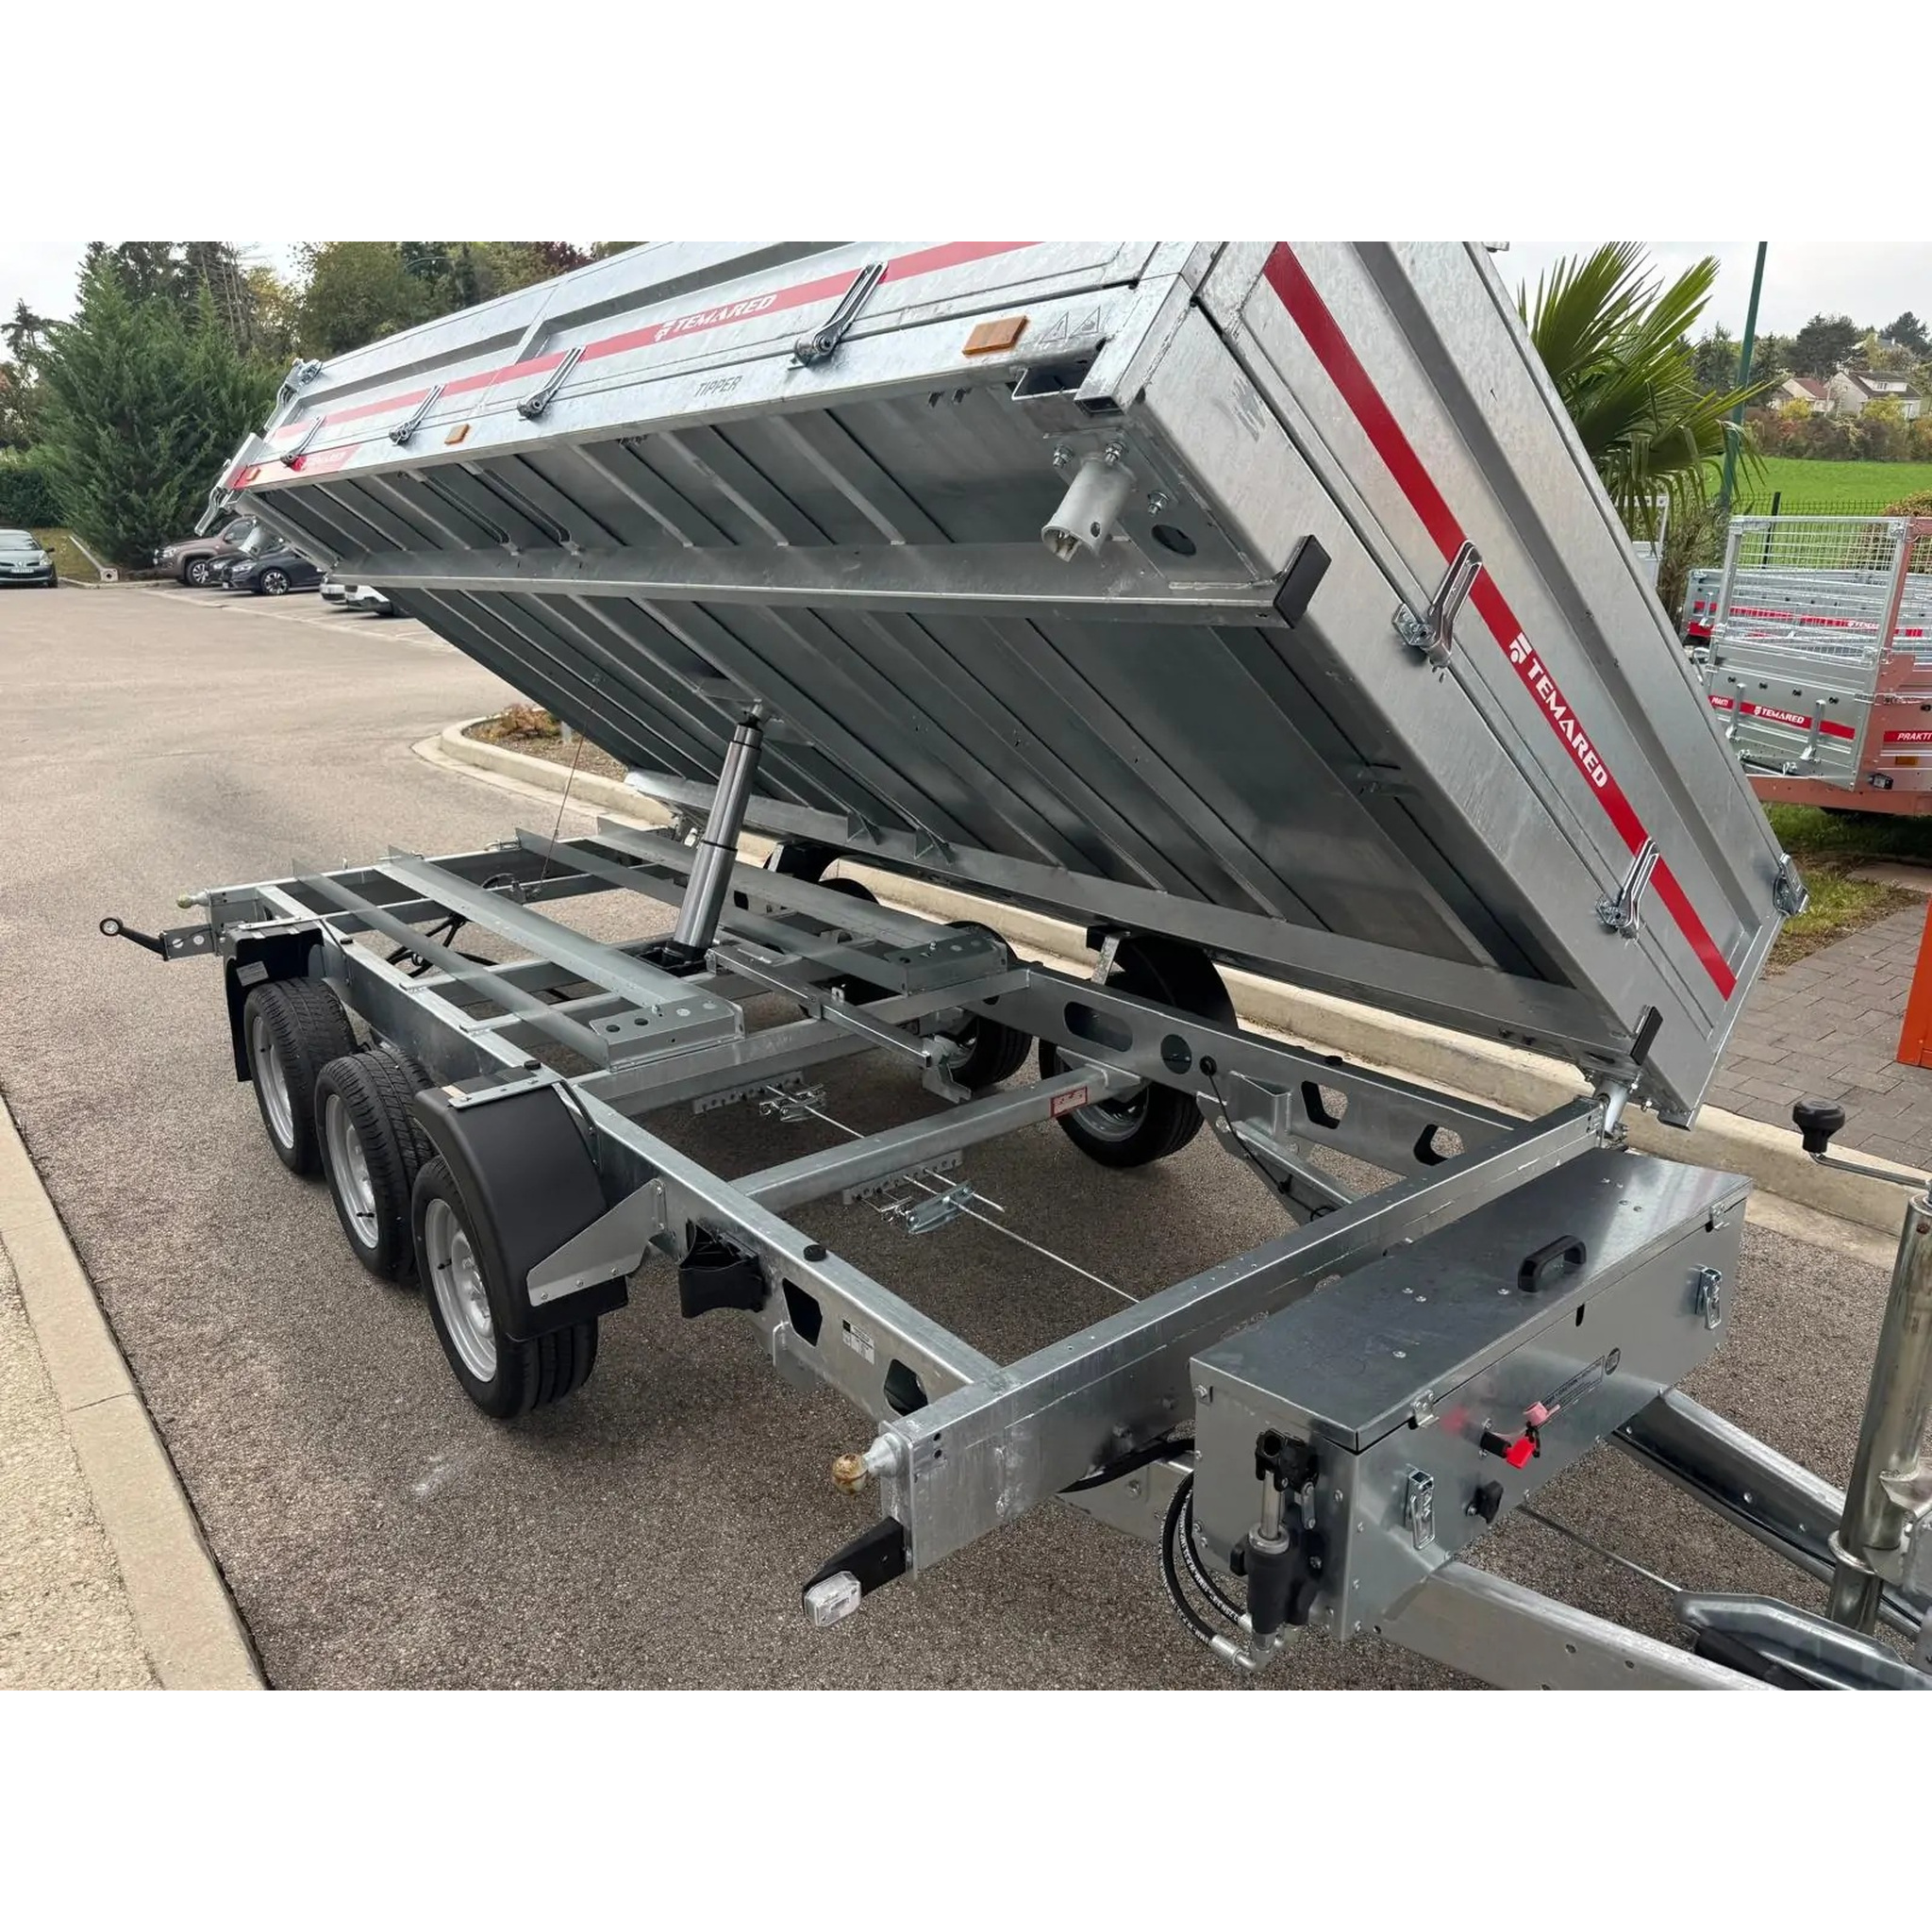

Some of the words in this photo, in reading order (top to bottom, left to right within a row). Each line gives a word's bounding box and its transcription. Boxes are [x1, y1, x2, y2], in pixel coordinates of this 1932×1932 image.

[674, 293, 777, 333] TEMARED
[694, 375, 743, 397] TIPPER
[1526, 658, 1608, 788] TEMARED
[1760, 708, 1806, 724] TEMARED
[1896, 731, 1932, 741] PRAKTI
